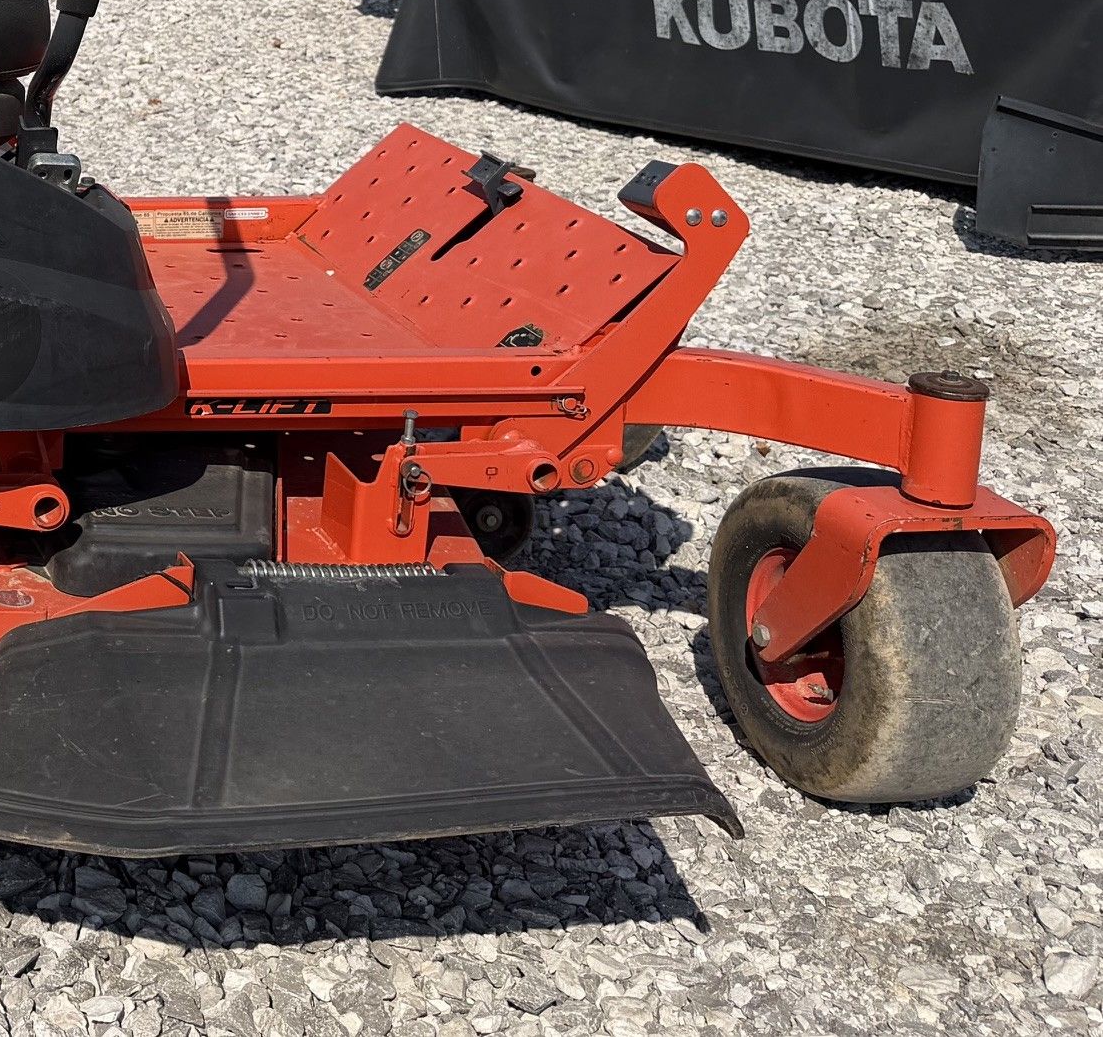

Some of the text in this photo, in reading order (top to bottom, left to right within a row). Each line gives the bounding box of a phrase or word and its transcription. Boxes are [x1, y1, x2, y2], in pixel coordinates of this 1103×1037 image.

[190, 399, 328, 414] K-LIFT
[148, 506, 232, 520] STEP
[302, 600, 490, 622] DO NOT REMOVE
